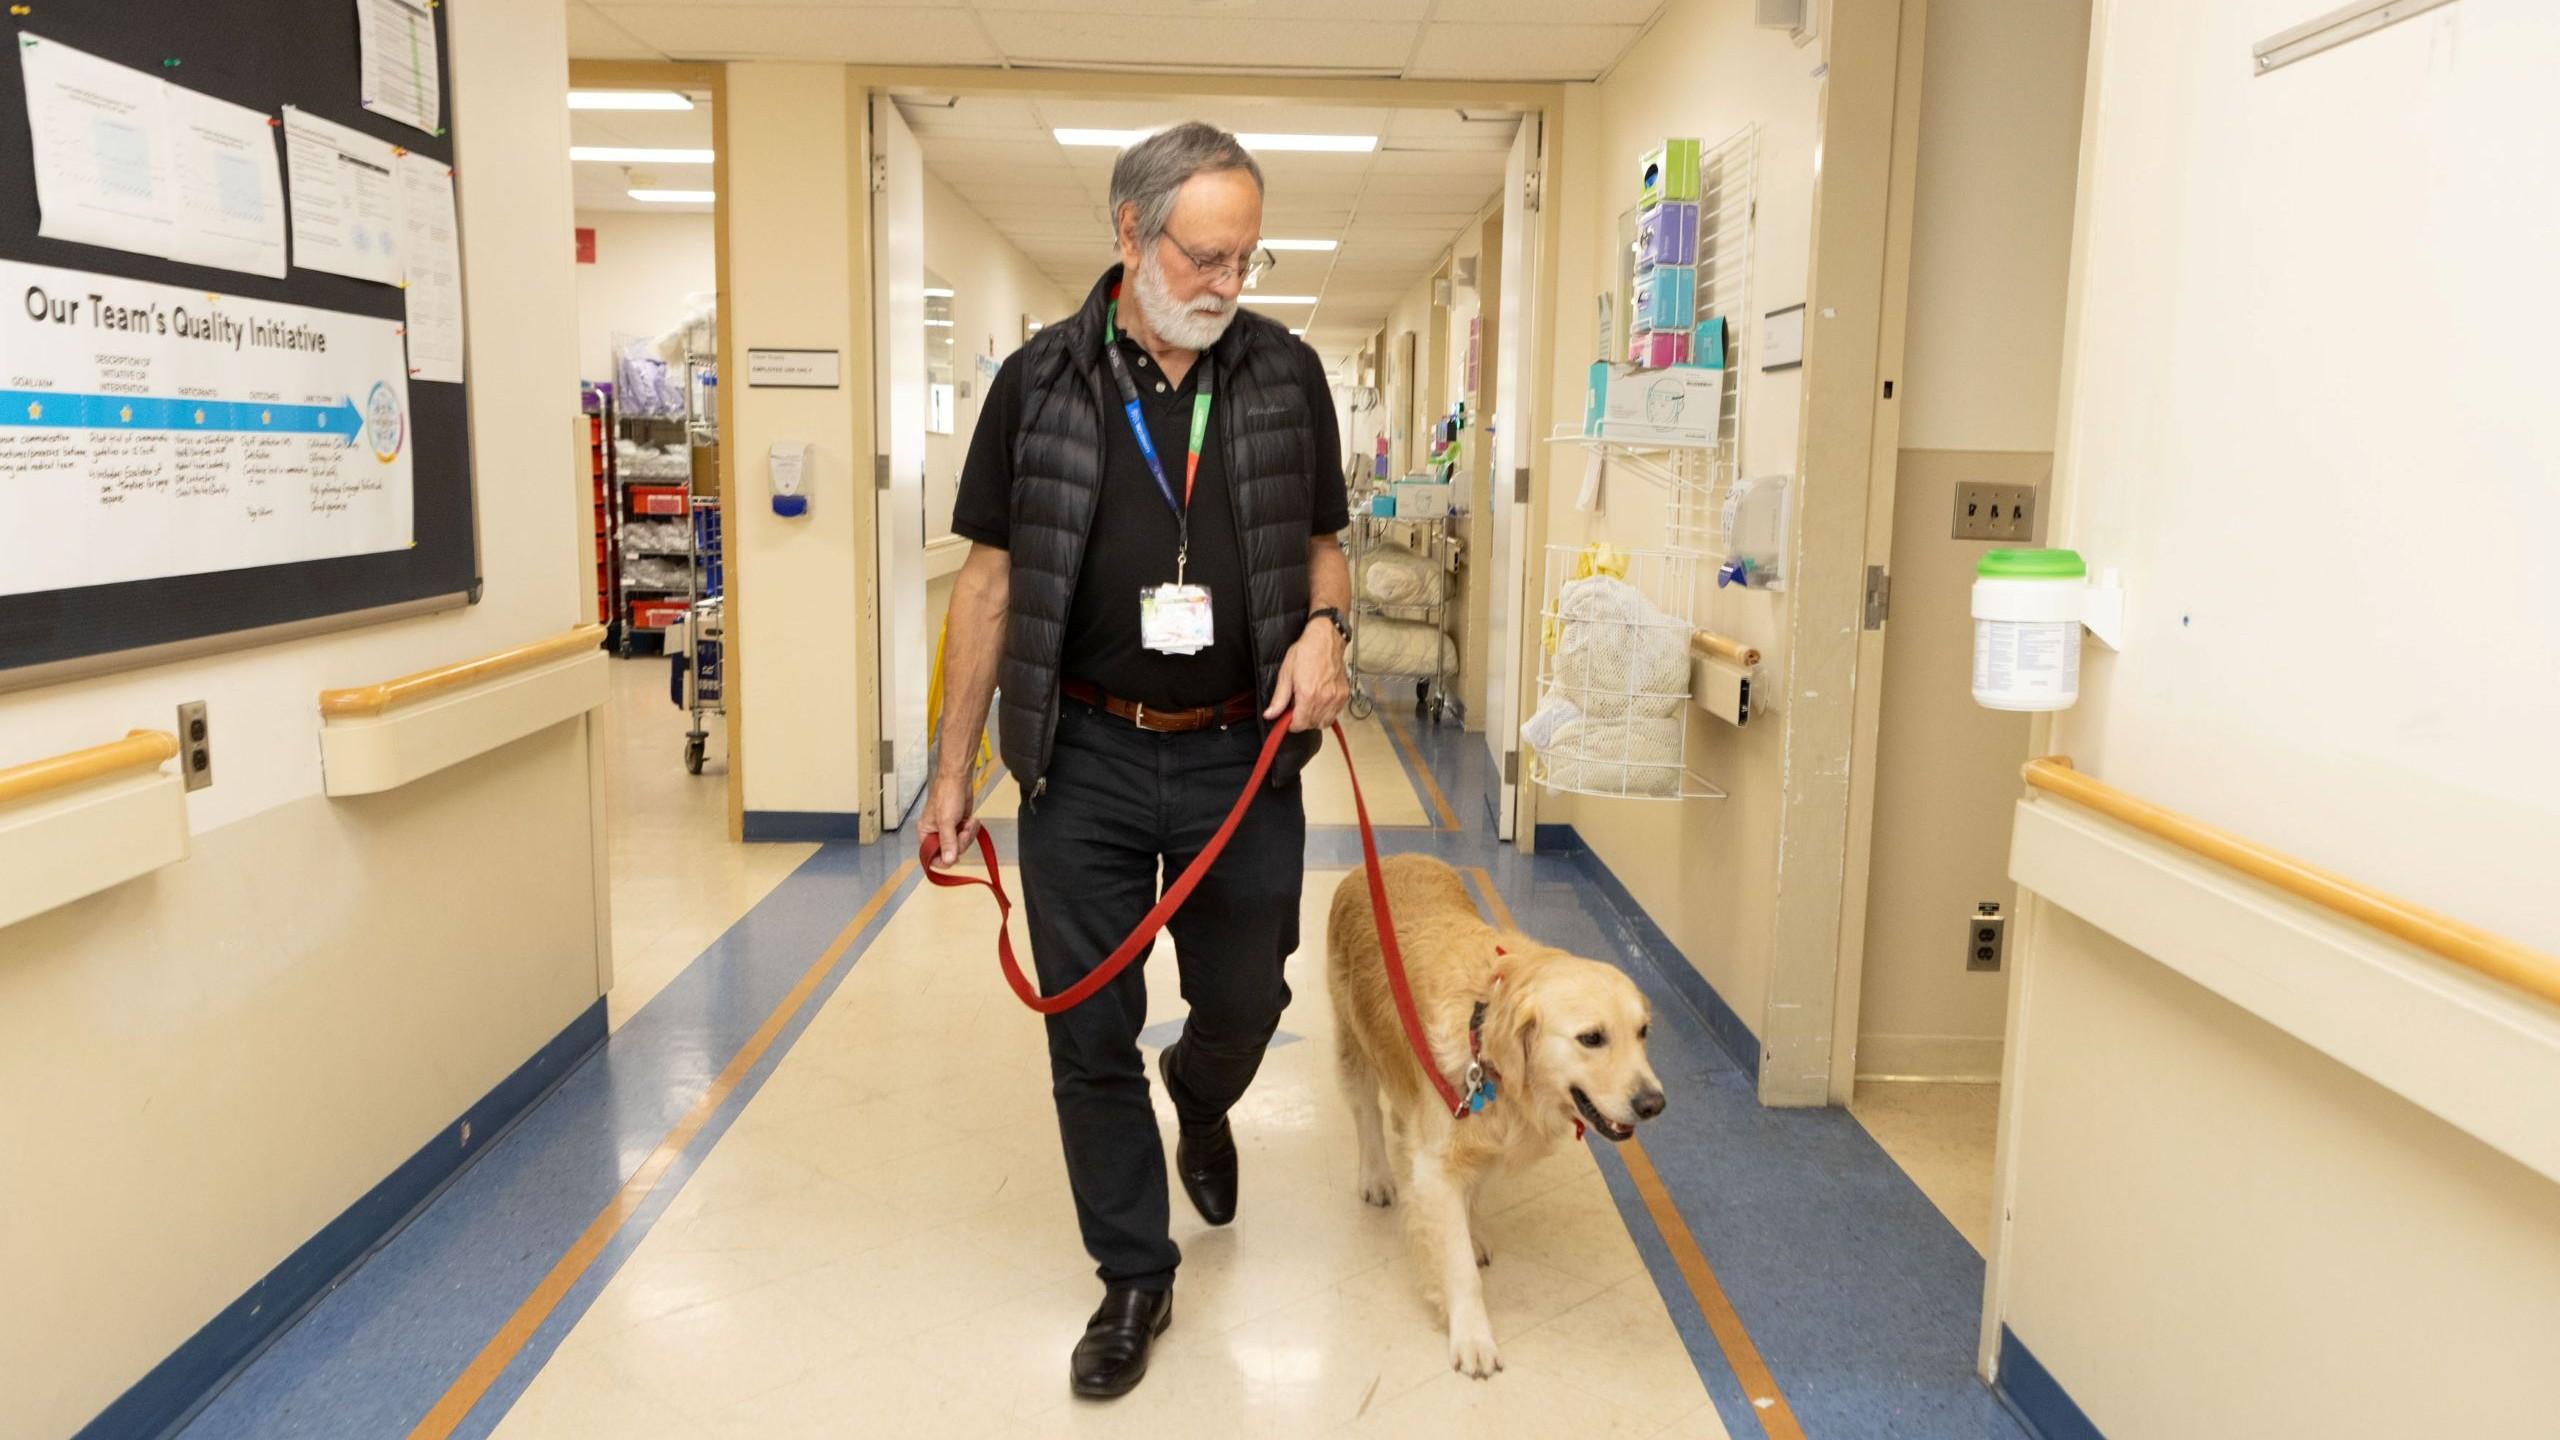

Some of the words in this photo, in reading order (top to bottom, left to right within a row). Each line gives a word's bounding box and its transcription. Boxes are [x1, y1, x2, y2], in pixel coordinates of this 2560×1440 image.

[26, 286, 79, 325] Our
[88, 294, 166, 335] Team's
[172, 306, 243, 351] Quality
[249, 317, 327, 353] Initiative
[95, 354, 140, 366] DESCRIPTION
[100, 383, 149, 394] INTERVENTION
